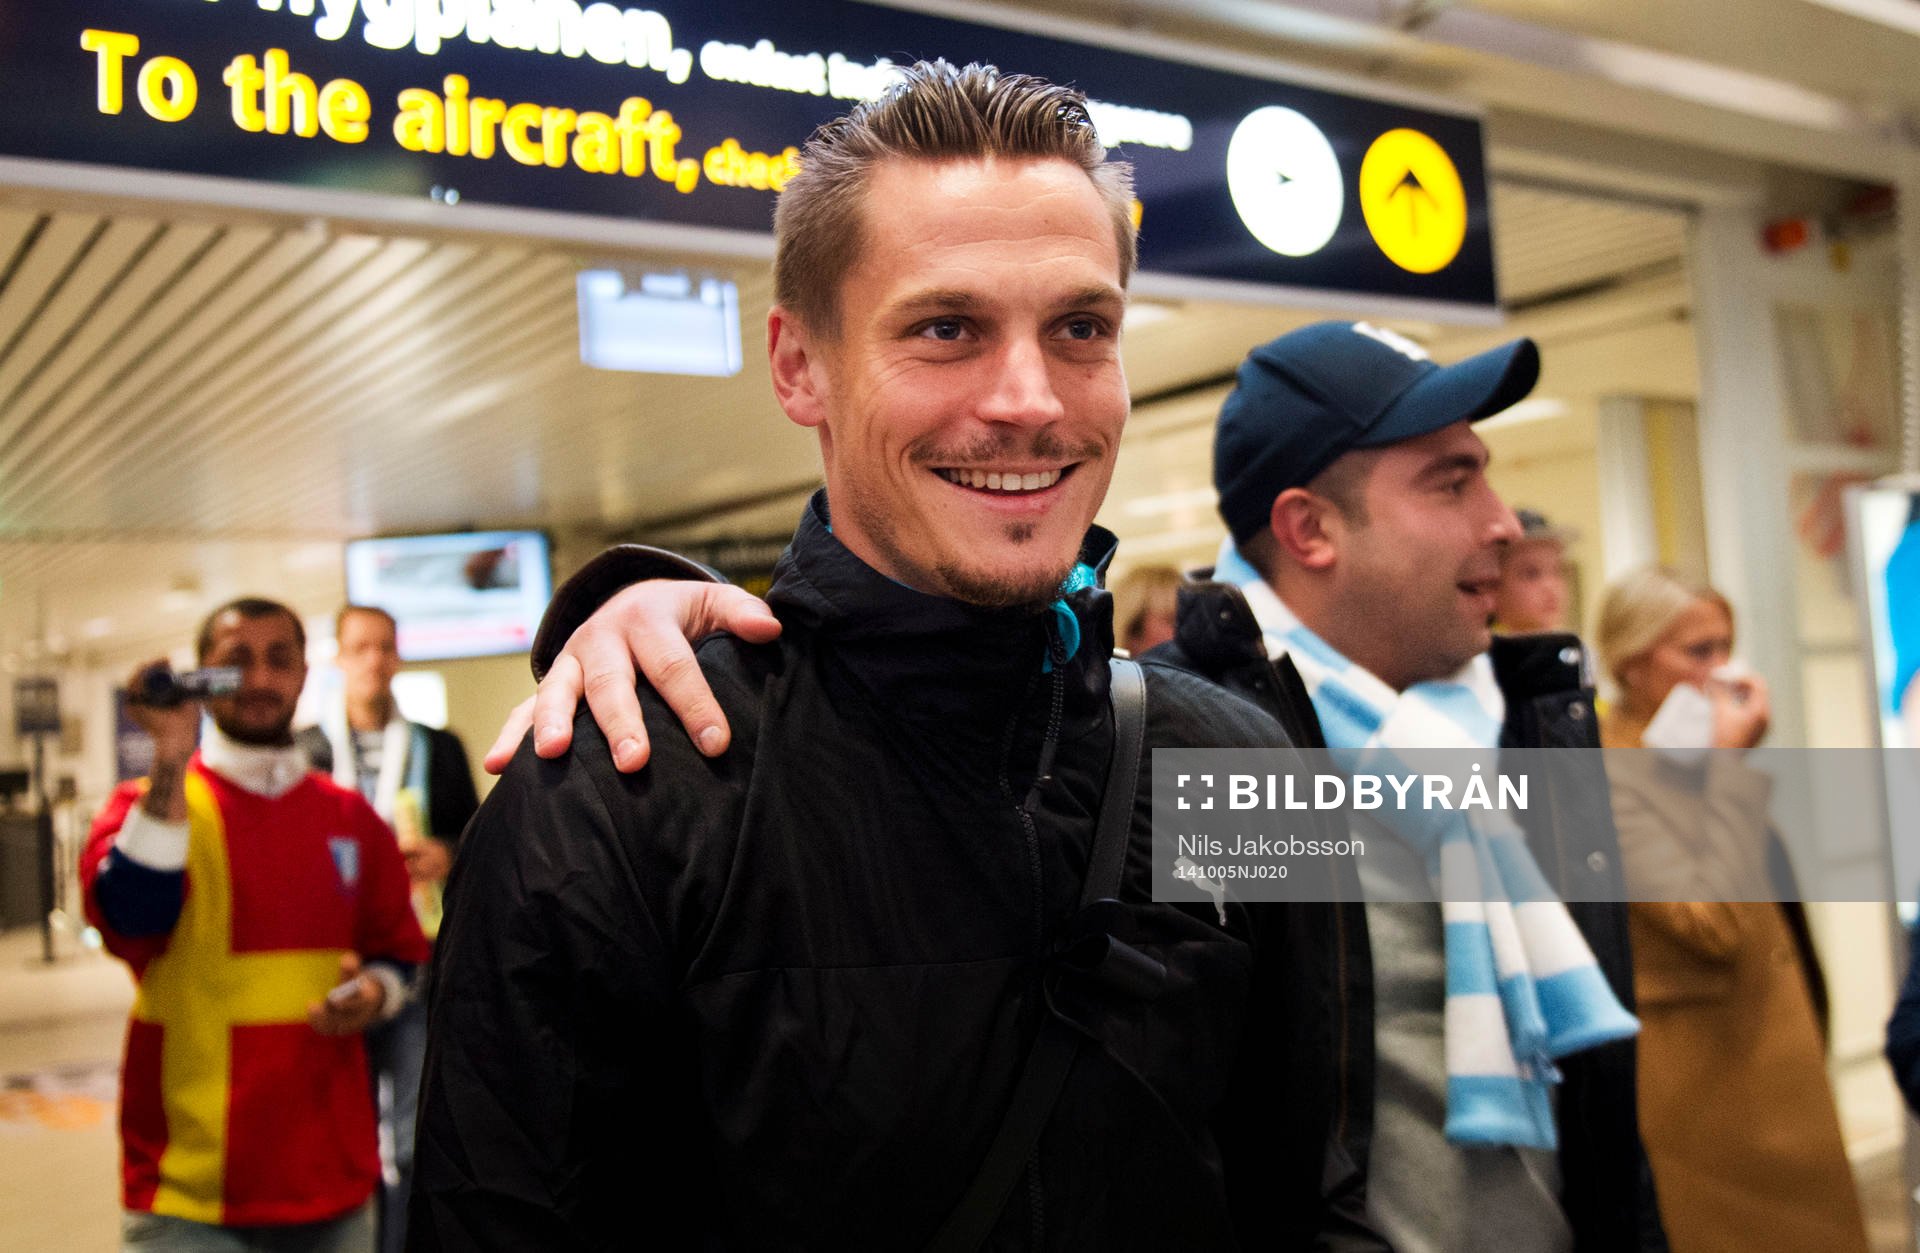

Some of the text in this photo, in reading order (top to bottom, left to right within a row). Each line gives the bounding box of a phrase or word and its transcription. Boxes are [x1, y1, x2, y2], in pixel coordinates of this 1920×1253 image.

[81, 28, 198, 122] To
[223, 47, 371, 143] the
[393, 74, 701, 194] aircraft,
